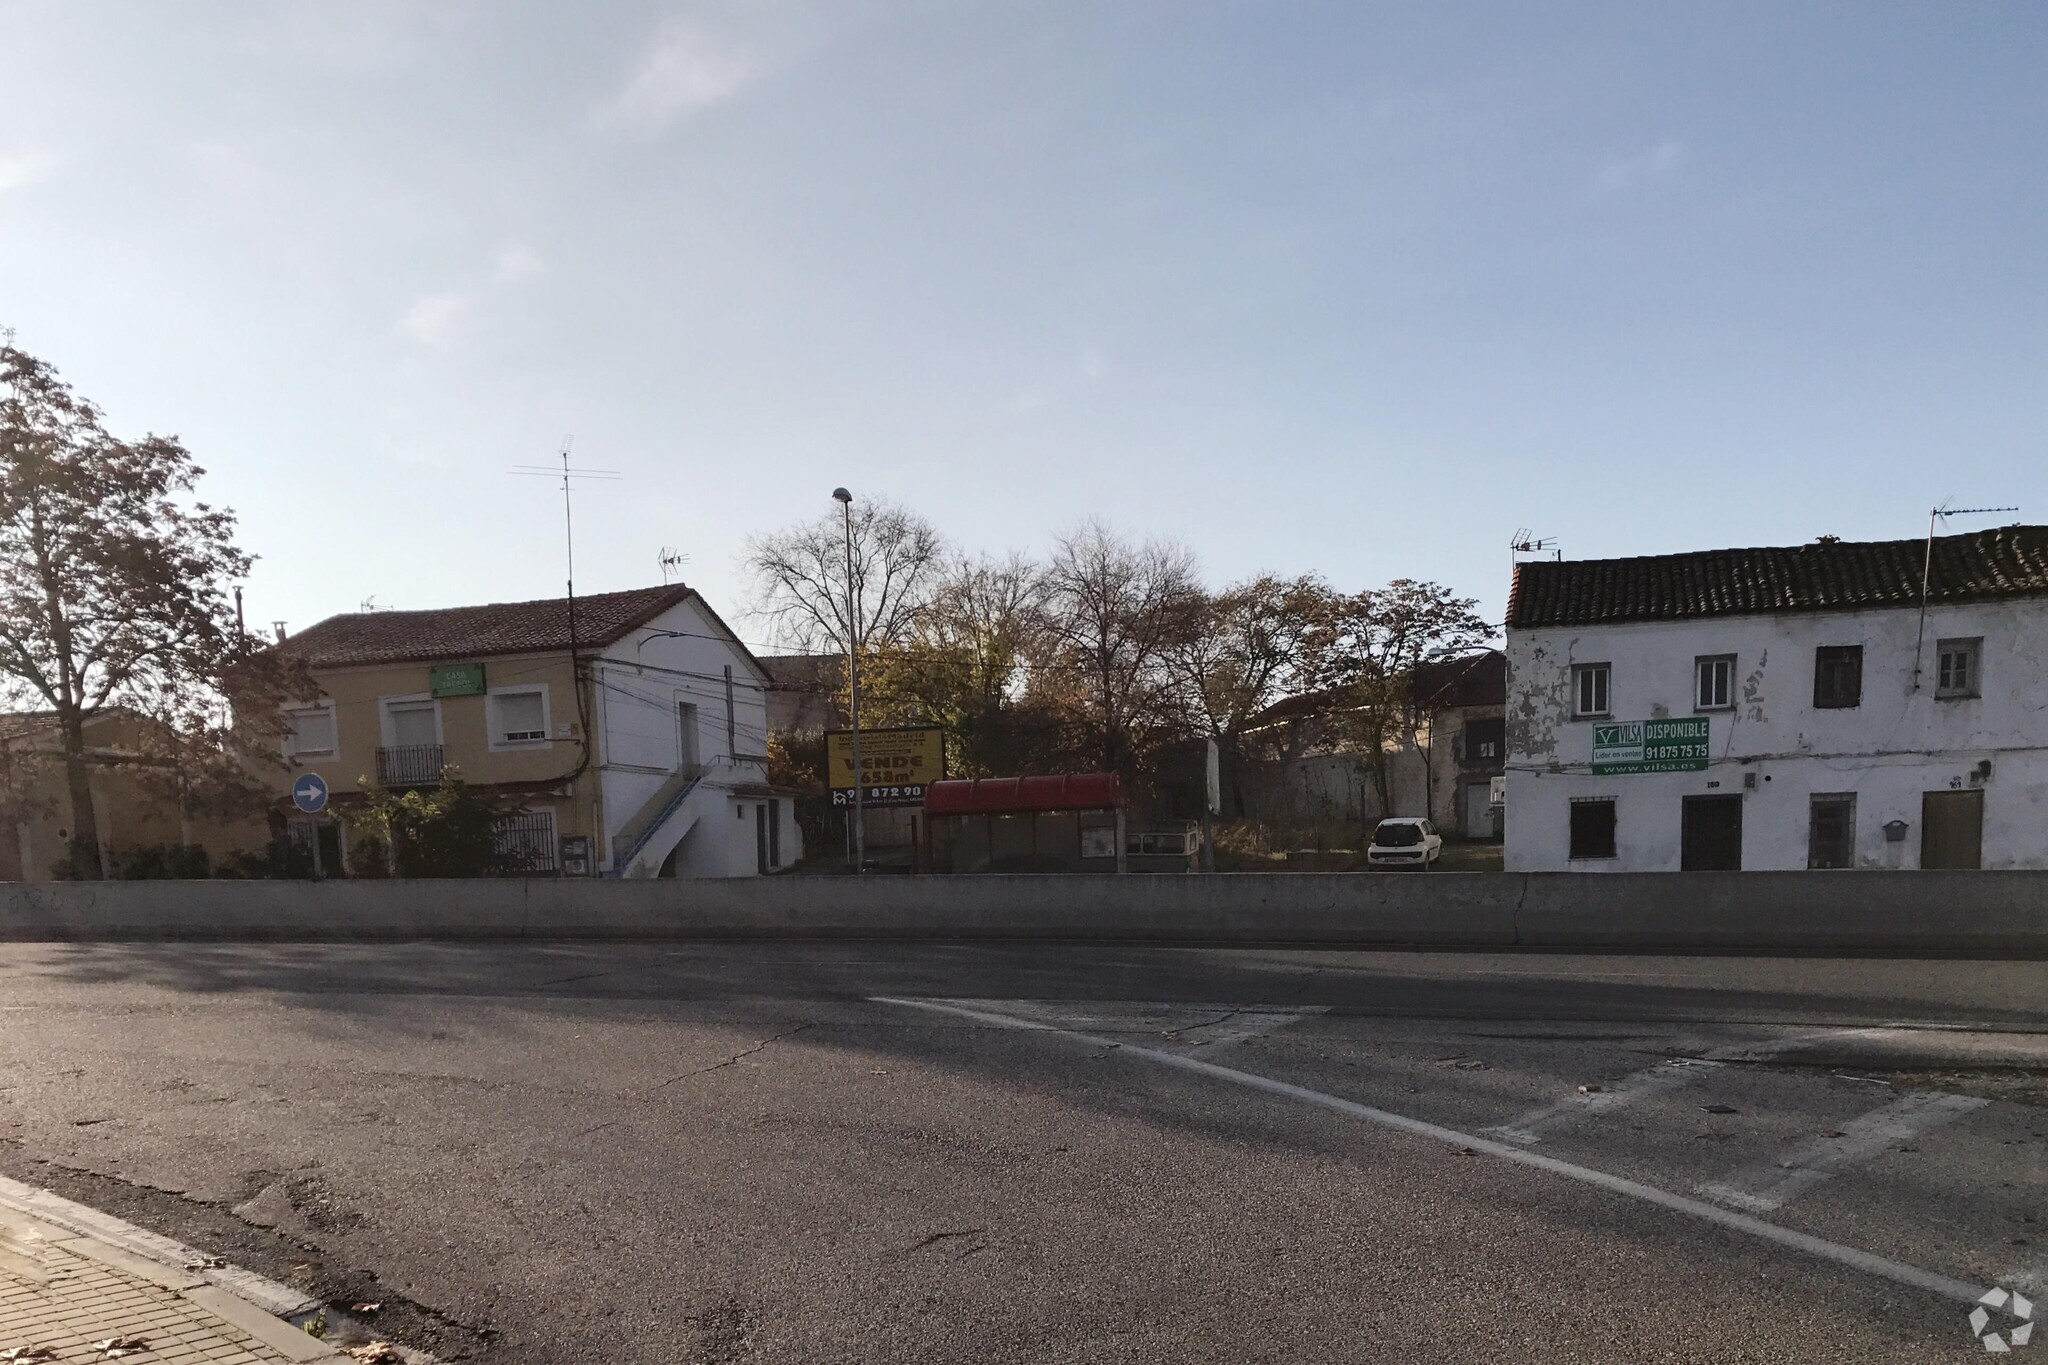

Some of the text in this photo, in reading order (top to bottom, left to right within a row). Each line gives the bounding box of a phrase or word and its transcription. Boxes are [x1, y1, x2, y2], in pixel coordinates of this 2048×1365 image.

[446, 671, 467, 680] CASA
[1620, 724, 1642, 743] VILSA
[1646, 722, 1707, 739] DISPONIBLE
[1646, 744, 1707, 759] 91 875 75 75
[1604, 763, 1696, 773] www.vilsa.es
[871, 787, 900, 798] 872
[904, 786, 921, 796] 90
